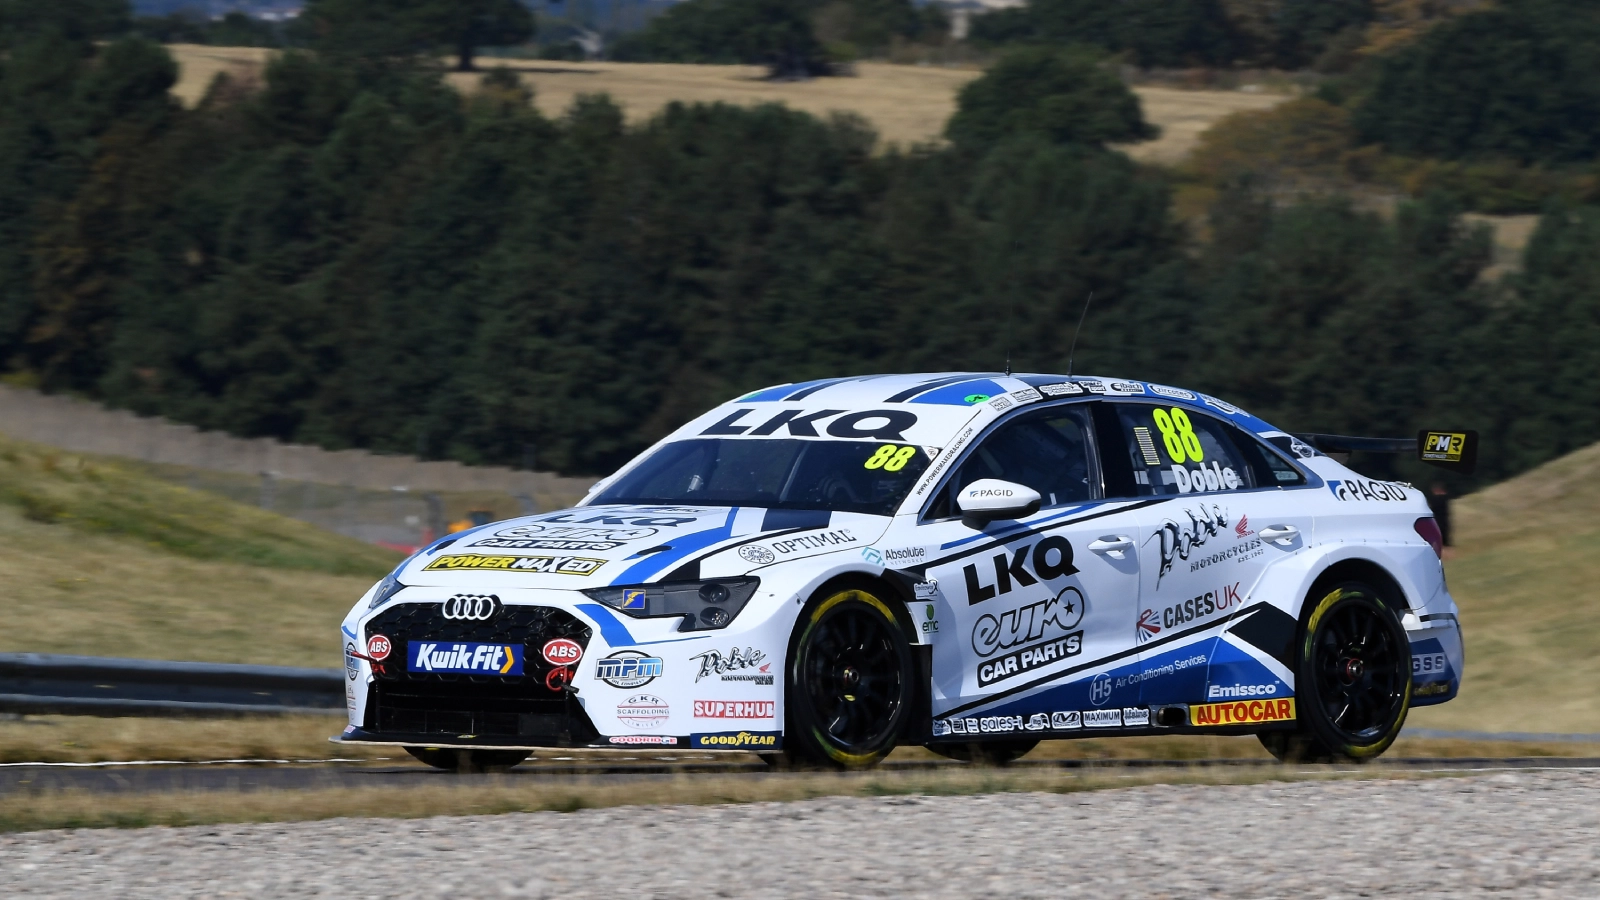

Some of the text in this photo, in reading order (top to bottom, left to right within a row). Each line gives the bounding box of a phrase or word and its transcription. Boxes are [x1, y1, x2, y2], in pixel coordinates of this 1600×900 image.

[697, 408, 918, 441] LKQ
[1152, 407, 1204, 464] 88
[864, 444, 916, 471] 88
[1171, 461, 1238, 493] Doble
[980, 489, 1013, 497] PAGID
[1344, 480, 1408, 502] PAGID
[537, 514, 697, 527] LKQ
[475, 539, 619, 550] CAR PARTS
[772, 530, 857, 554] OPTIMAL
[885, 547, 925, 560] Absolute
[1190, 537, 1262, 572] MOTORCYCLES
[963, 535, 1081, 606] LKQ
[922, 621, 939, 631] emc
[972, 586, 1085, 657] euro
[370, 642, 388, 653] ABS
[549, 645, 578, 657] ABS
[980, 635, 1080, 682] CAR PARTS
[1116, 654, 1206, 688] Air Conditioning Services
[628, 695, 659, 704] GKR
[1092, 677, 1112, 701] H5
[1208, 683, 1277, 698] Emissco
[1084, 711, 1120, 721] MAXIMUM
[1197, 699, 1291, 725] AUTOCAR
